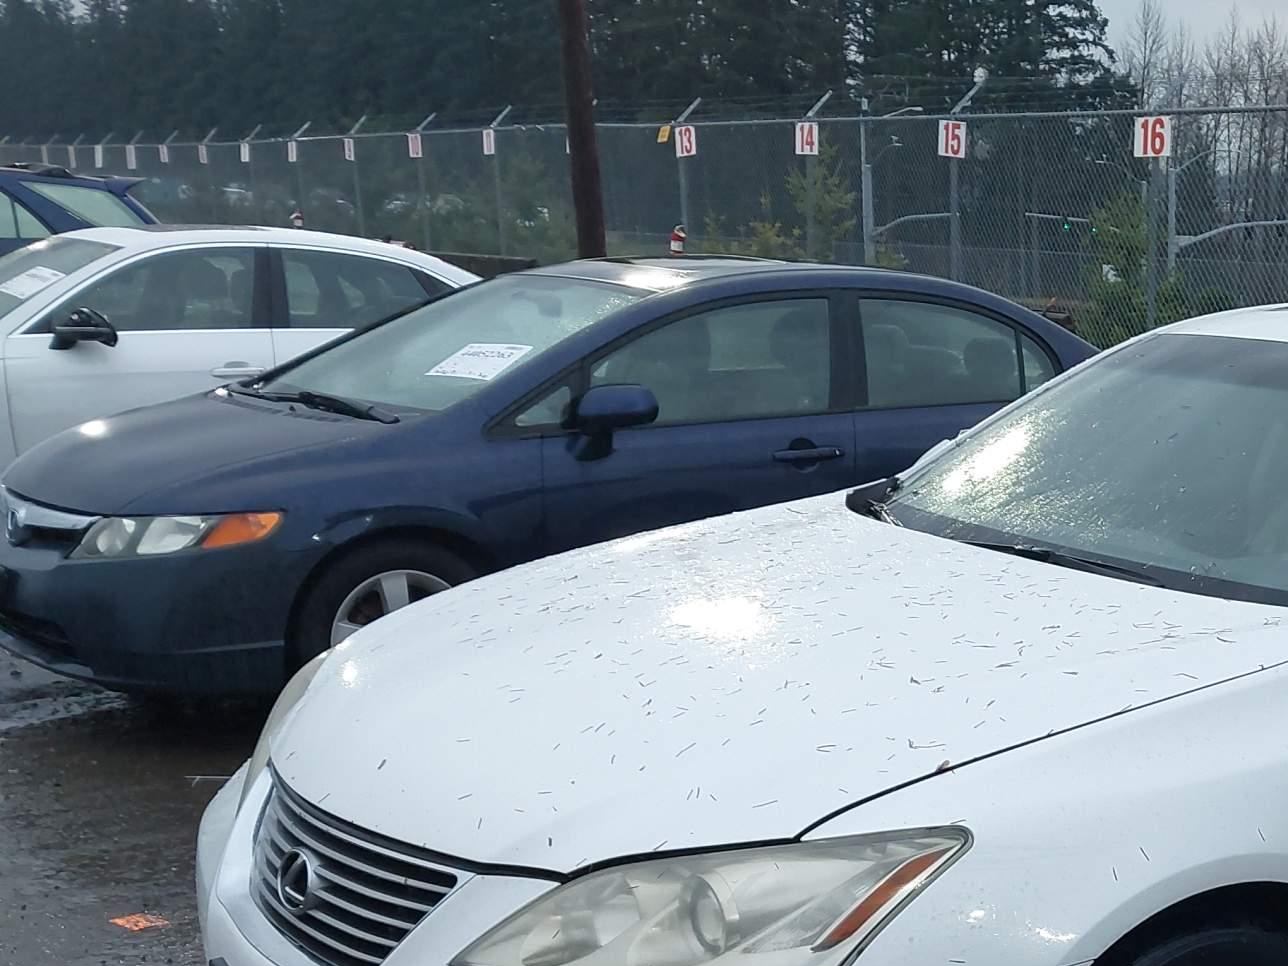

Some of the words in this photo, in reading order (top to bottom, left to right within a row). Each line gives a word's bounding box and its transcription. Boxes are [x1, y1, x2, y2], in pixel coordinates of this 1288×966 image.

[679, 127, 692, 154] 13
[799, 123, 815, 153] 14
[944, 122, 962, 155] 15
[1141, 118, 1166, 156] 16
